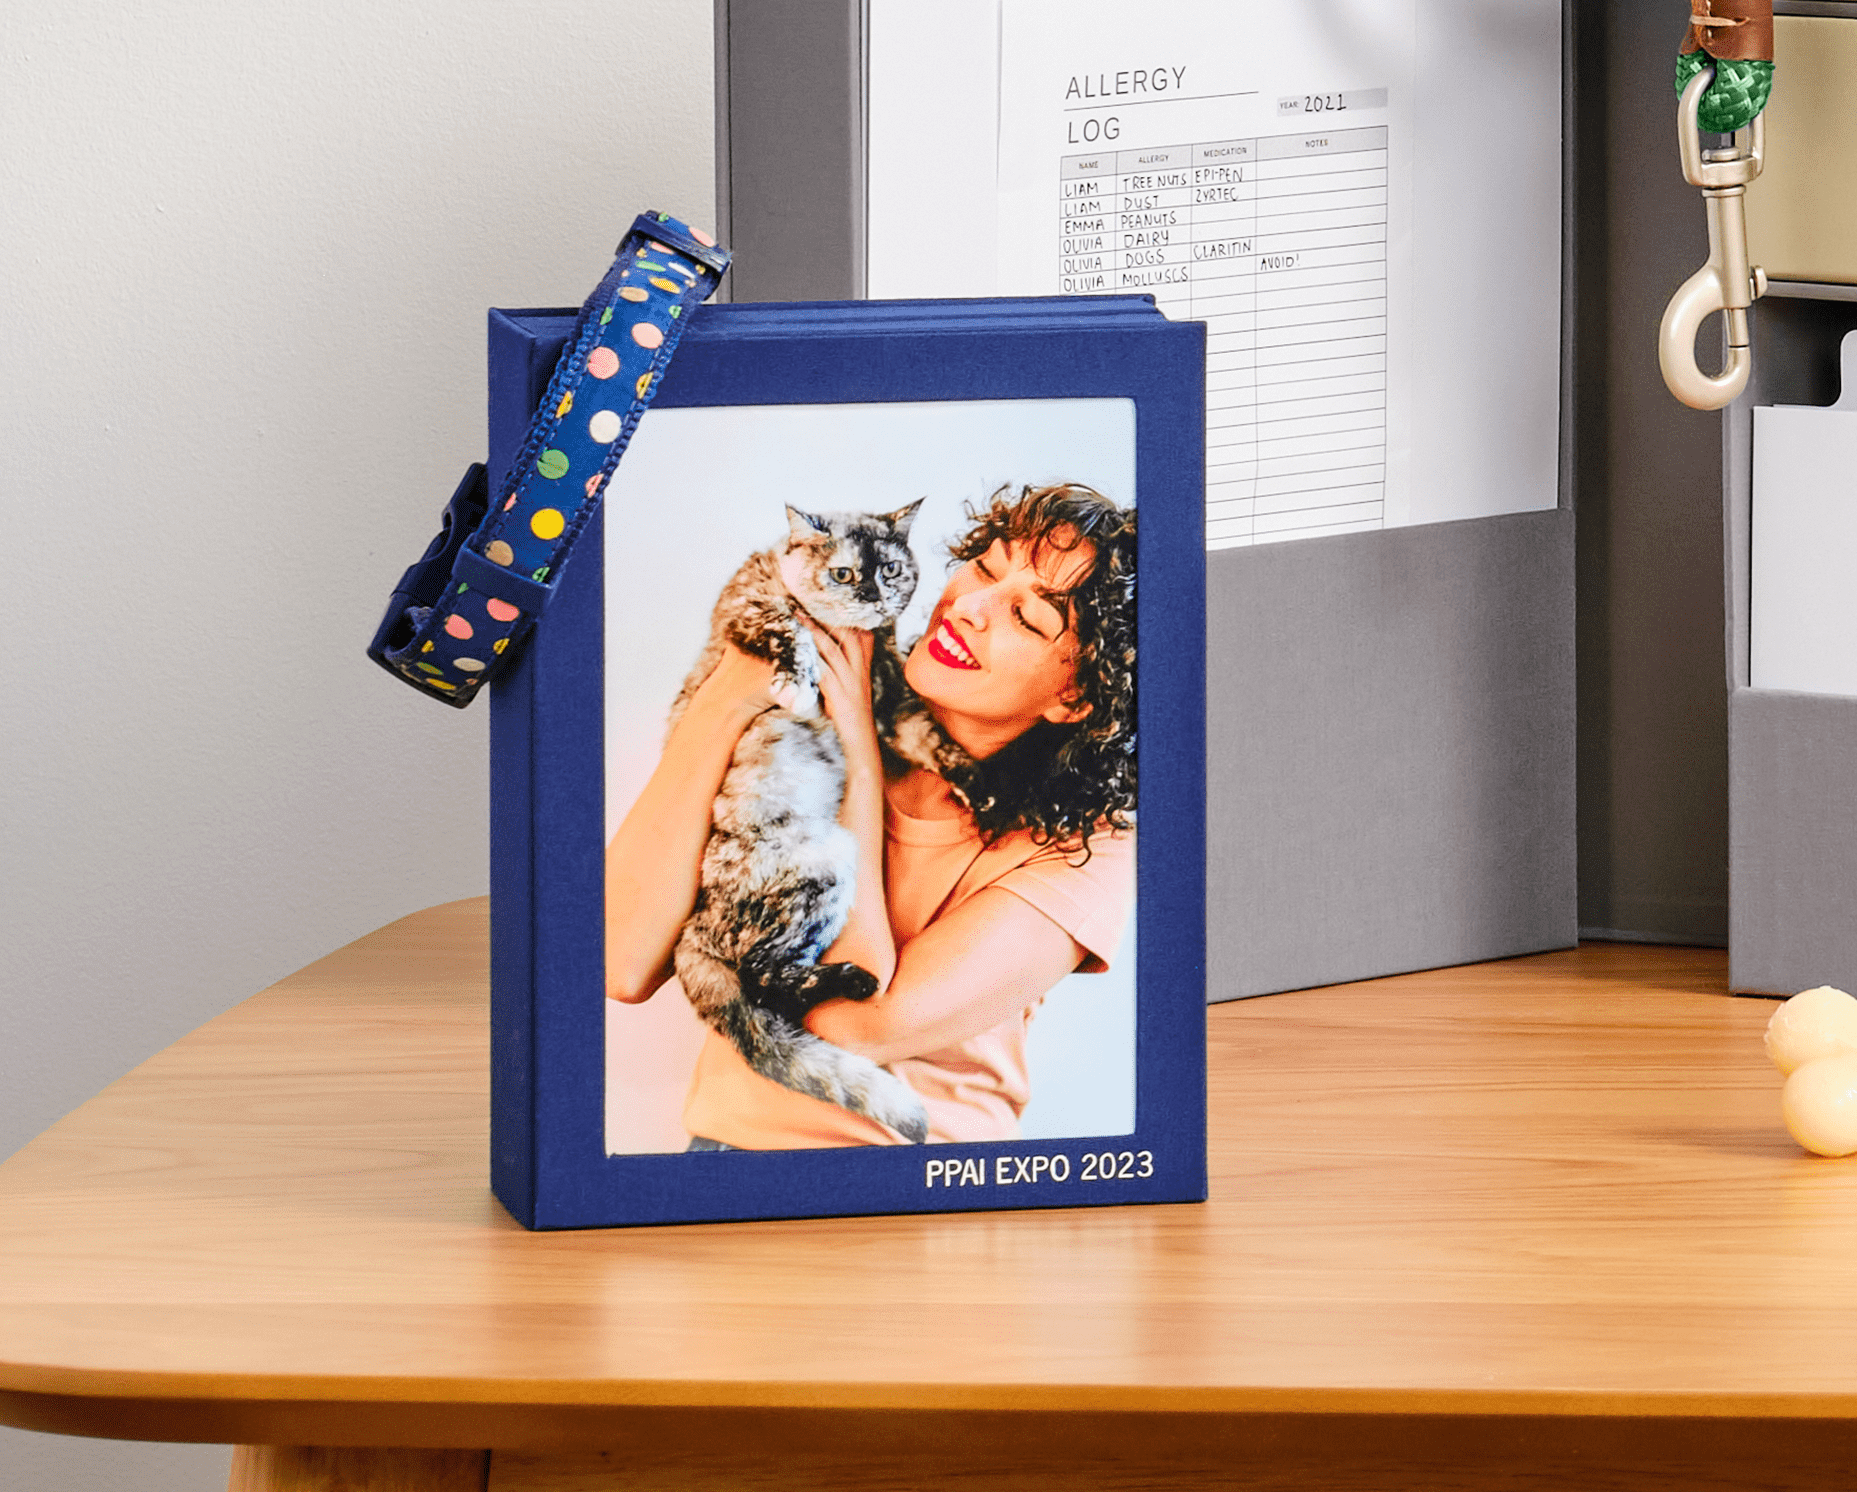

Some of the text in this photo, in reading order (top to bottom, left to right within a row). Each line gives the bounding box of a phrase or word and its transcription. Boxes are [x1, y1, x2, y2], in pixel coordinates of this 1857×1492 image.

[1065, 65, 1187, 100] ALLERGY
[1305, 93, 1347, 112] 2021
[1068, 116, 1120, 144] LOG
[1079, 138, 1328, 169] NAME ALLERGY MEDICATION NOTES
[1065, 167, 1243, 198] LIAM TREE NUTS EPI-PEN
[1065, 187, 1239, 217] LIAM DUST ZYRTEC
[1064, 210, 1177, 235] EMMA PEANUTS
[1063, 230, 1169, 254] OLIVIA DAIRY
[1064, 239, 1252, 274] OLIVIA DOGS CLARITIN
[1260, 253, 1299, 271] AVOID!
[1064, 266, 1189, 293] OLIVIA MOLLUSCS
[925, 1150, 1154, 1189] PPAI EXPO 2023
